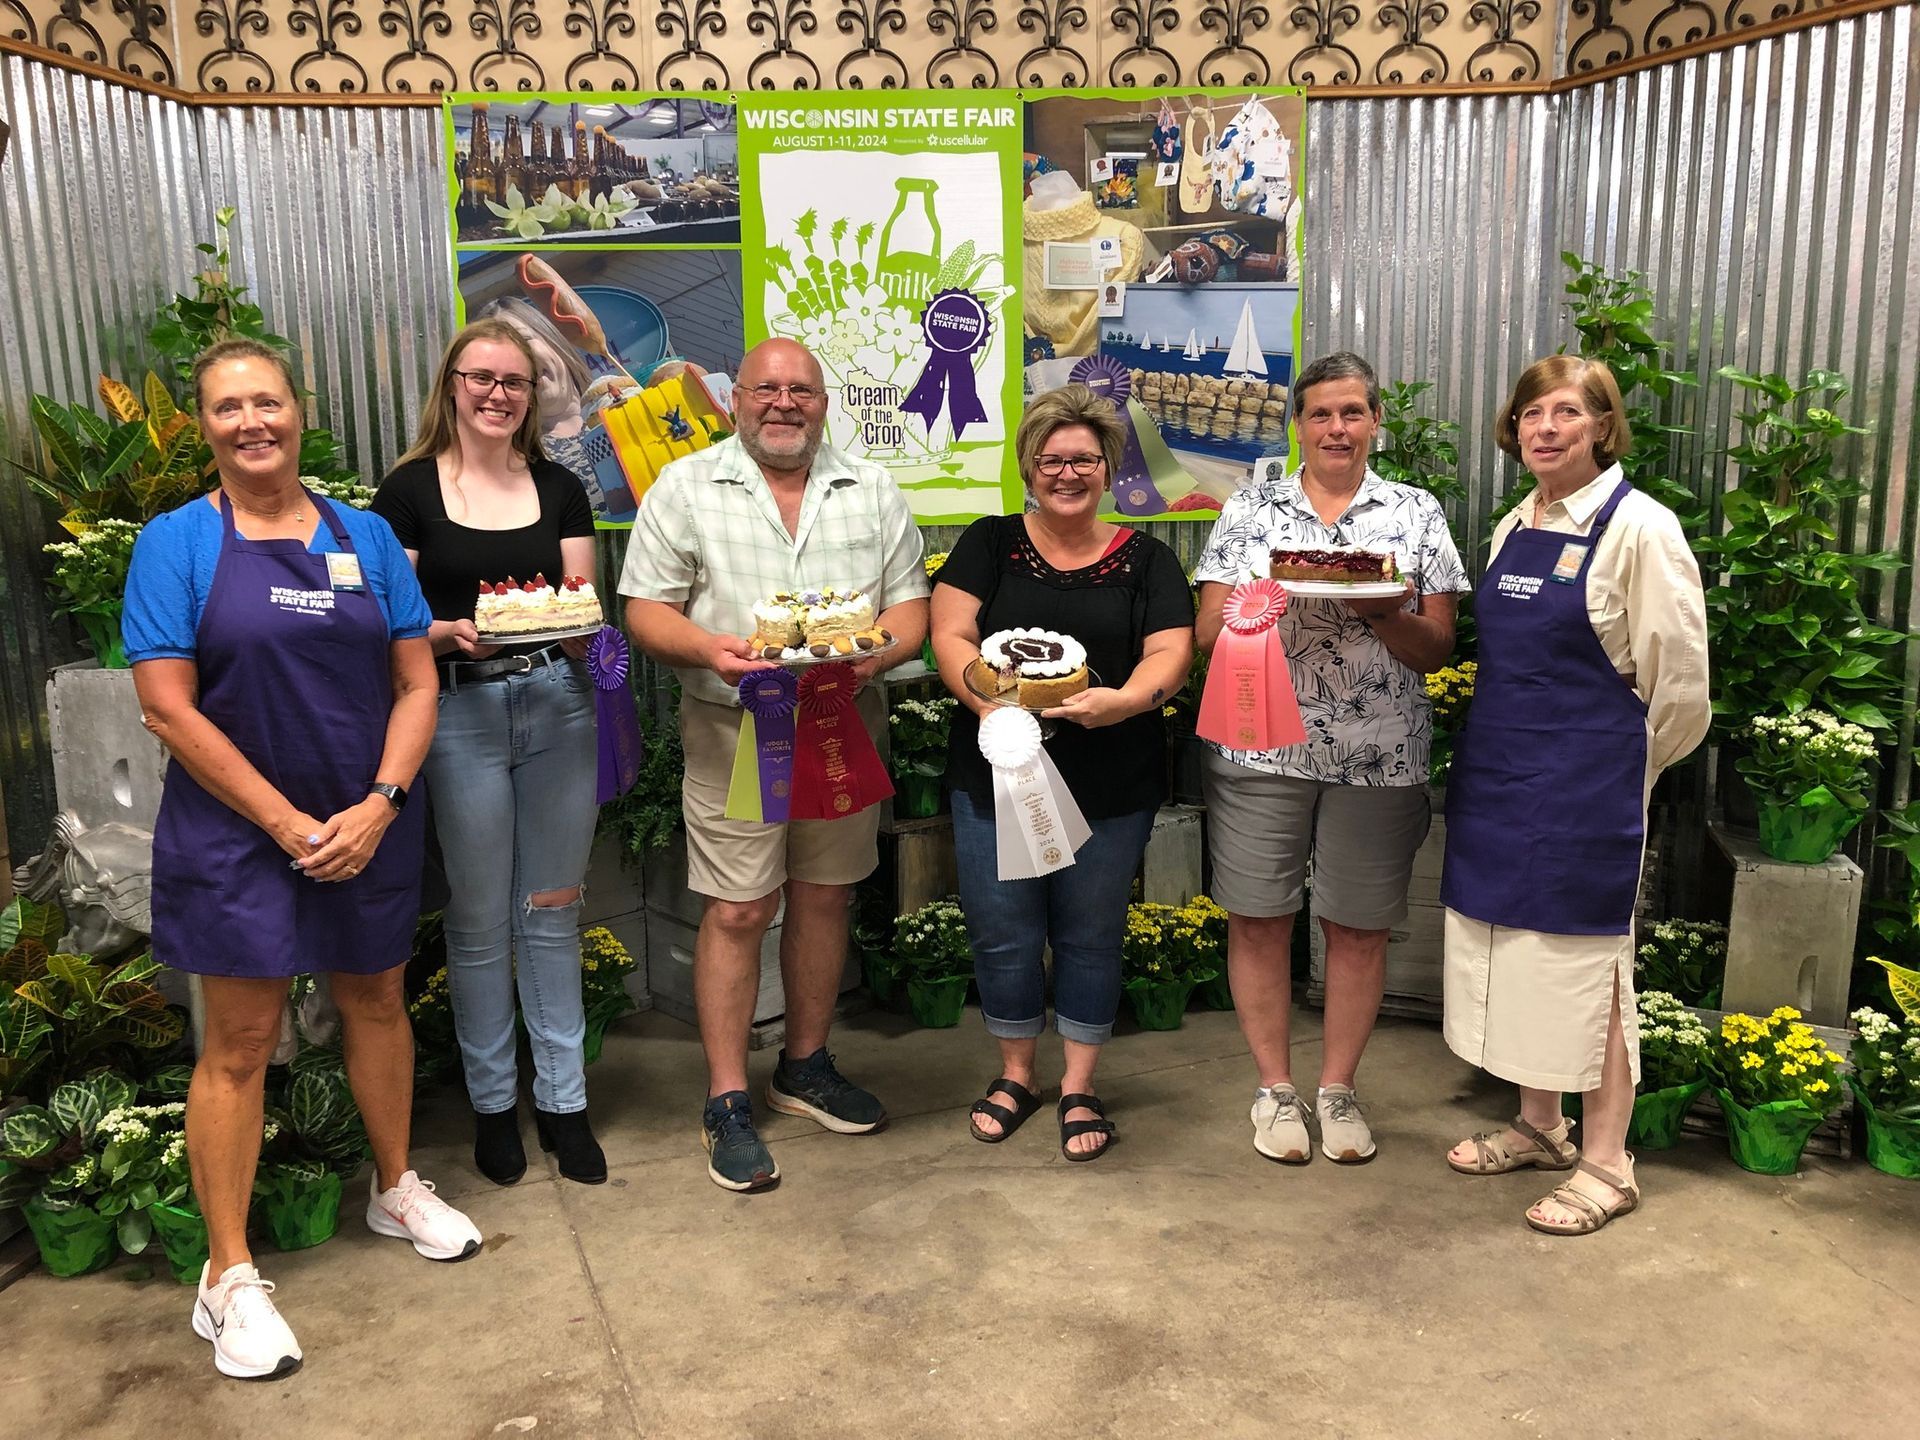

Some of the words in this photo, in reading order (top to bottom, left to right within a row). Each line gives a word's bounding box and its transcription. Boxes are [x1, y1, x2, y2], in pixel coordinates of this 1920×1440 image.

[743, 109, 879, 129] WISCONSIN
[884, 108, 958, 128] STATE
[964, 108, 1016, 127] FAIR
[772, 135, 825, 147] AUGUST
[857, 135, 888, 147] 2024
[939, 134, 989, 146] uscellular
[880, 269, 936, 301] milk
[933, 311, 979, 326] WISCONSIN
[932, 320, 957, 330] STATE
[959, 324, 977, 333] FAIR
[847, 384, 898, 406] Cream
[861, 407, 872, 421] of
[874, 409, 893, 424] the
[864, 422, 901, 447] Crop
[1500, 574, 1544, 587] WISCONSIN
[270, 586, 335, 600] WISCONSIN
[1497, 582, 1521, 592] STATE
[1521, 585, 1540, 594] FAIR
[270, 595, 308, 606] STATE
[309, 599, 335, 608] FAIR
[816, 715, 839, 725] SECOND
[1018, 776, 1036, 786] PLACE
[1039, 837, 1055, 847] 2024
